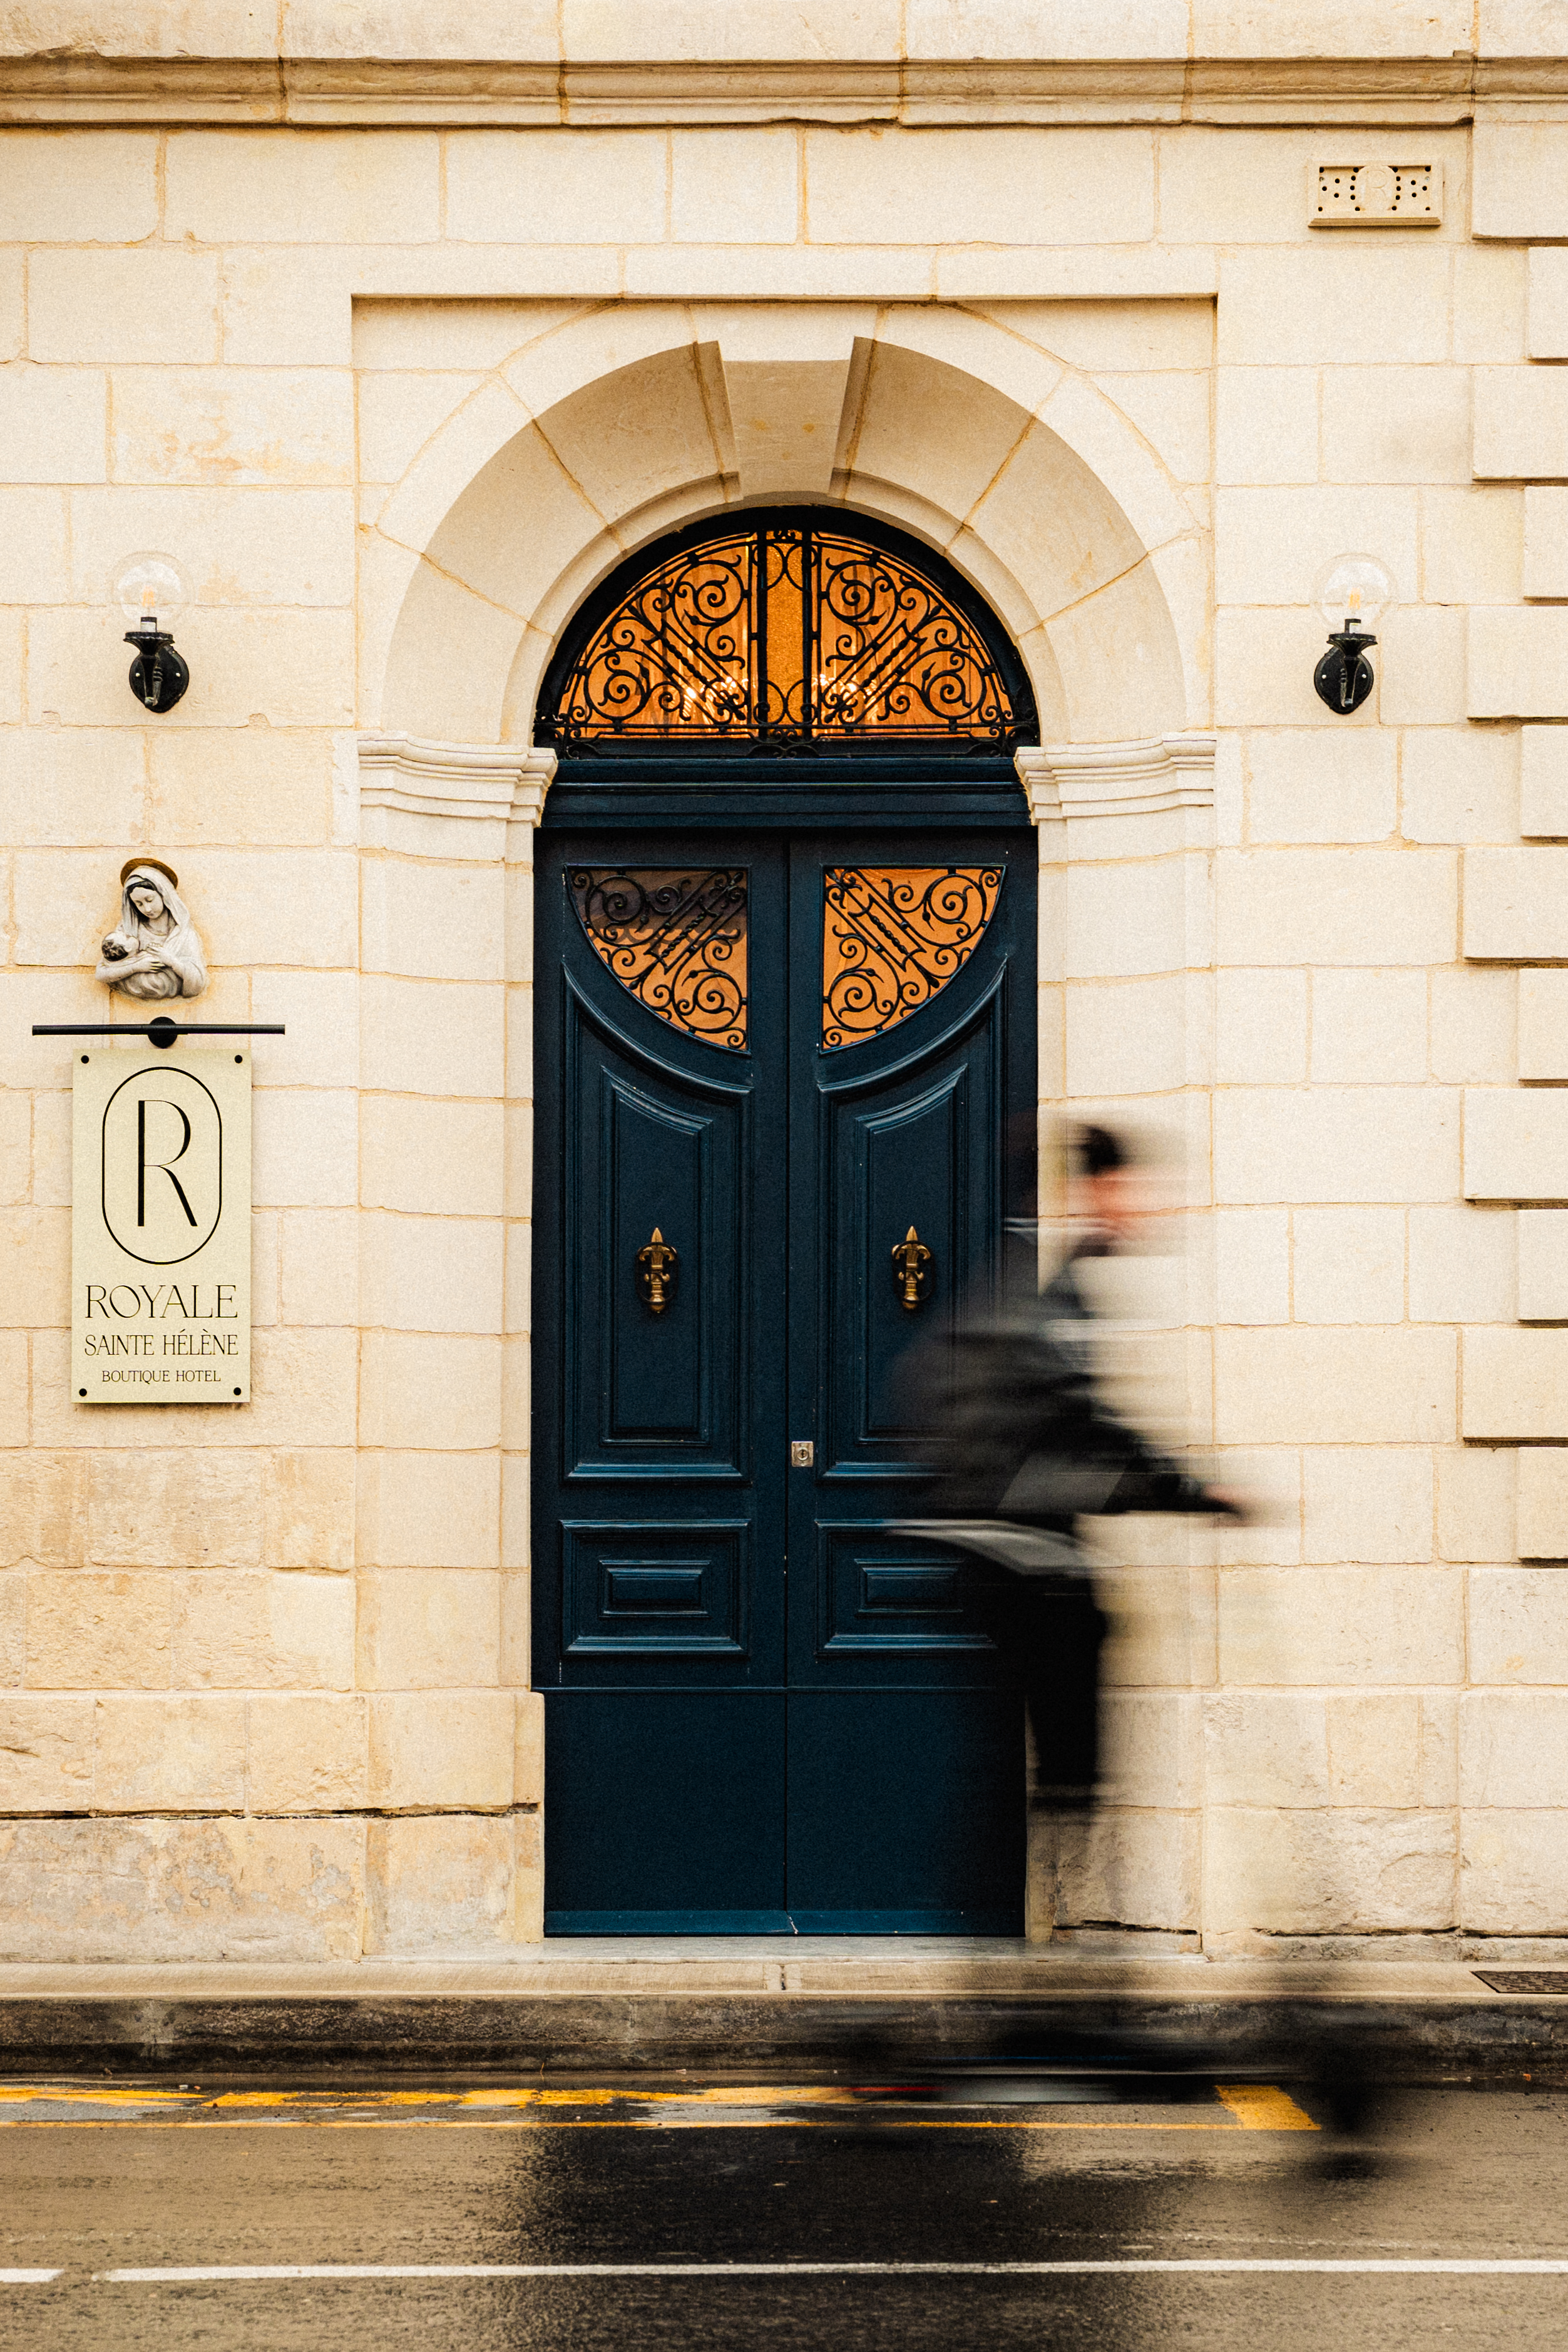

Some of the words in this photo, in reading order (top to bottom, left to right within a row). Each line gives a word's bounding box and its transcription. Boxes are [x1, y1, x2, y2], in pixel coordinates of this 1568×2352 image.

[138, 1100, 198, 1227] R
[85, 1285, 238, 1318] ROYALE
[85, 1334, 155, 1356] SAINTE
[163, 1328, 238, 1356] HÉLÈNE
[102, 1370, 170, 1385] BOUTIQUE
[176, 1370, 221, 1382] HOTEL
